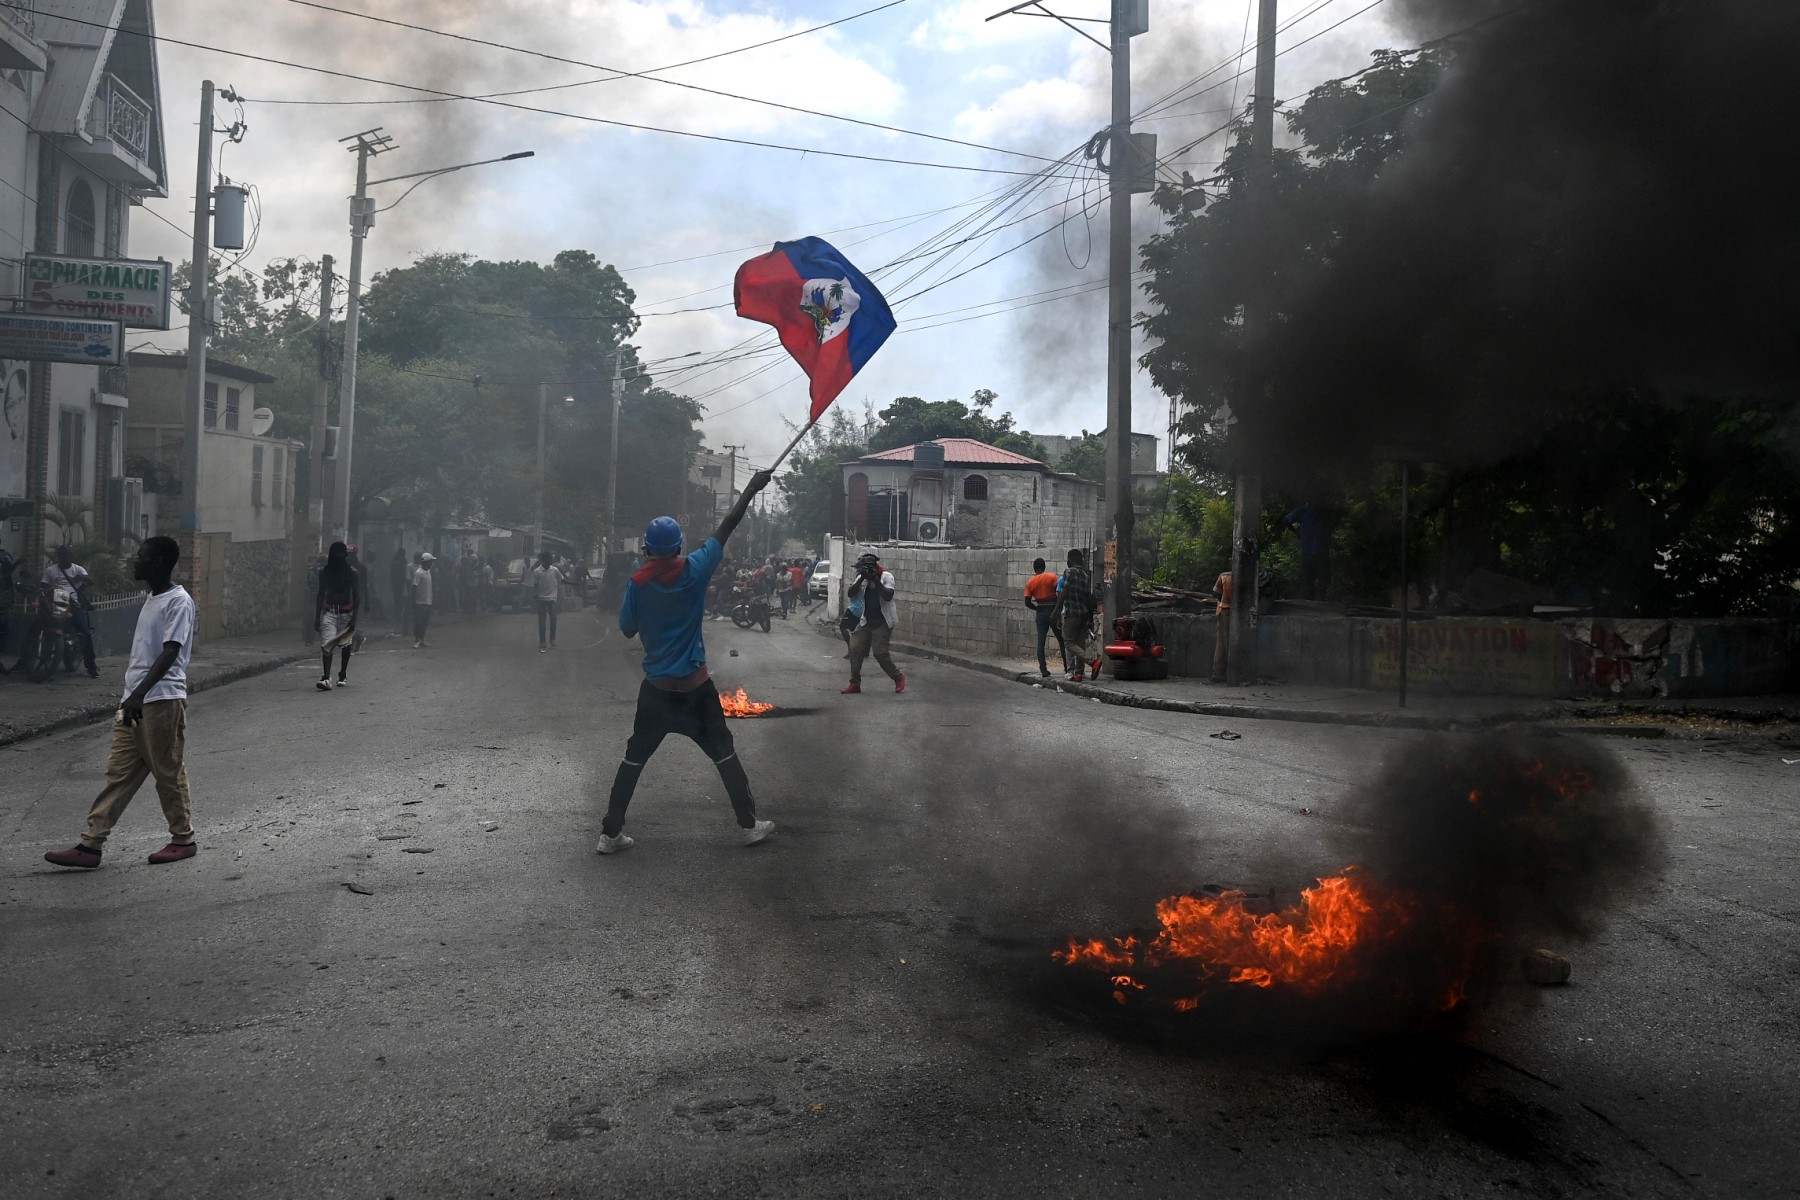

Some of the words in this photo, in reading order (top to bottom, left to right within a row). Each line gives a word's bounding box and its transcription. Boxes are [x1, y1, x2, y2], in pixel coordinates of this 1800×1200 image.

[53, 262, 160, 291] PHARMACIE
[30, 281, 53, 310] 5
[87, 290, 125, 301] DES
[57, 300, 154, 317] CONTINENTS
[34, 320, 48, 330] DES
[48, 321, 65, 332] CINQ
[66, 323, 113, 335] CONTINENTS
